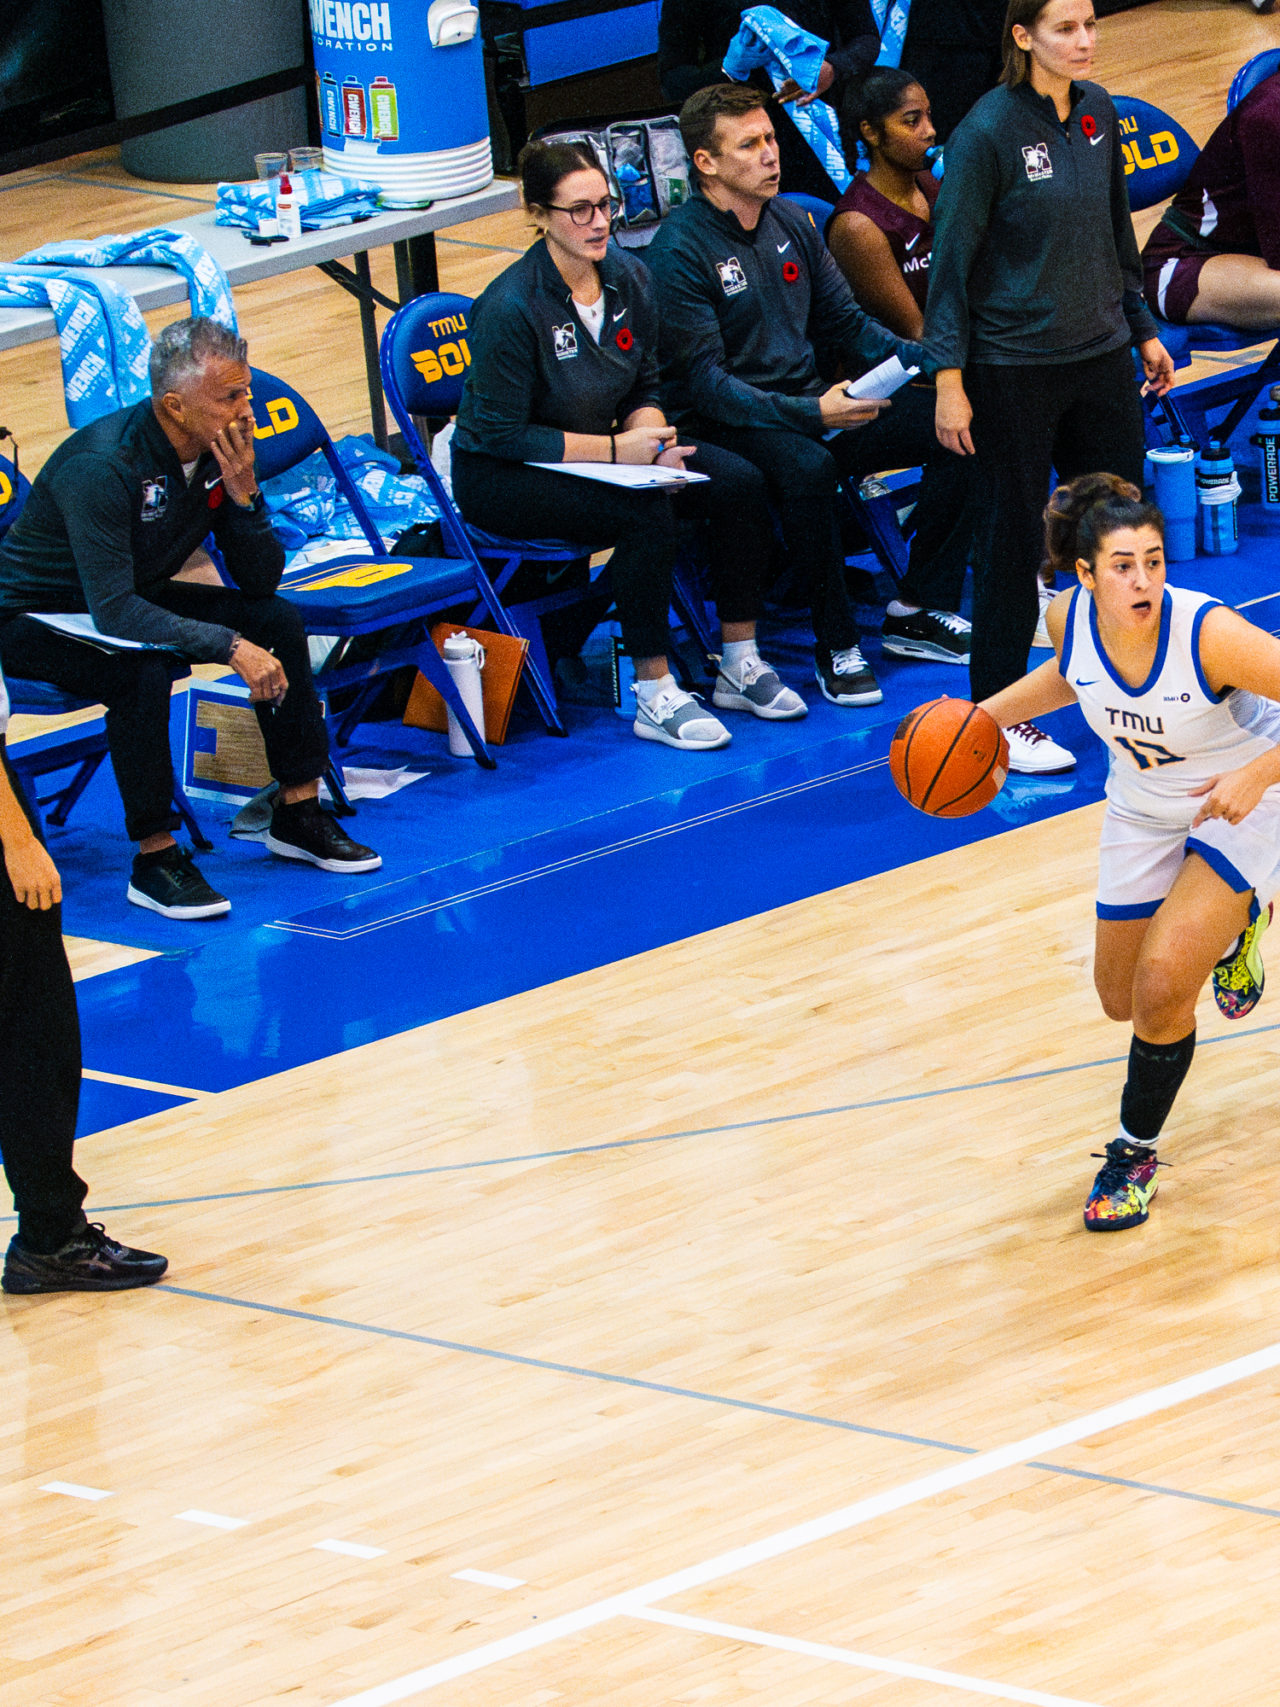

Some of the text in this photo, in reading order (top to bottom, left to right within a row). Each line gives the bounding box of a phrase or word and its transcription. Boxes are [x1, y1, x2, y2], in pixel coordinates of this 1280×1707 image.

[309, 0, 392, 41] WENCH
[312, 35, 393, 52] YDRATION
[427, 313, 469, 339] TMU
[1265, 435, 1280, 502] POWERADE
[1105, 706, 1165, 735] TMU
